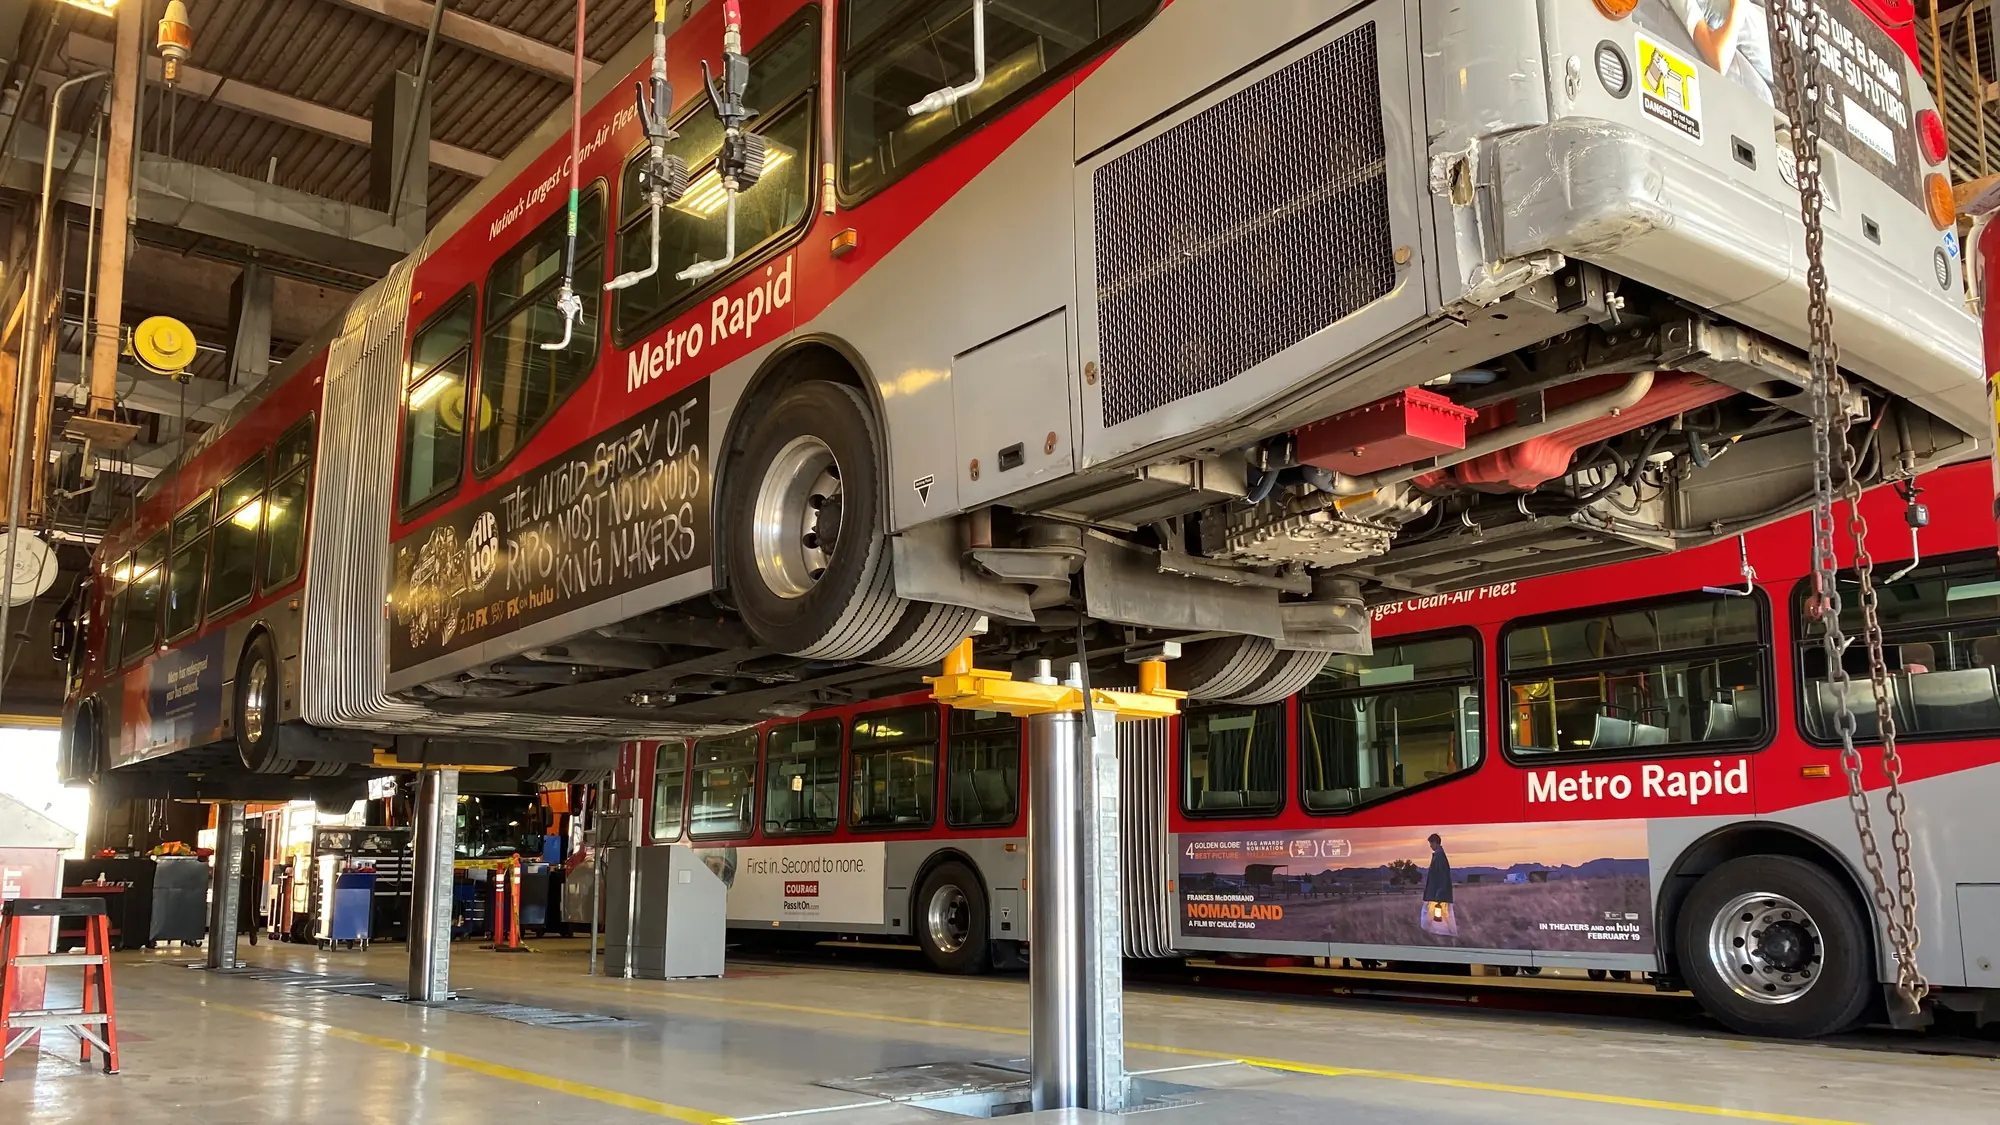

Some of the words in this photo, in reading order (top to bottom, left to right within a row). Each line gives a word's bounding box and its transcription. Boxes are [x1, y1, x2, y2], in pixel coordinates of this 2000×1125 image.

[1855, 35, 1869, 68] EL
[1868, 48, 1902, 96] PLOMO
[1843, 56, 1862, 92] SU
[1863, 71, 1907, 130] FUTURO
[1644, 97, 1672, 121] DANGER
[488, 196, 525, 241] Nation's
[525, 164, 562, 209] Largest
[562, 124, 610, 178] Can-Air
[627, 323, 704, 394] Metro
[710, 254, 793, 346] Rapid
[500, 485, 532, 532] THE
[532, 460, 588, 522] UNTOLD
[593, 418, 659, 488] STORY
[666, 397, 698, 457] OF
[557, 491, 608, 554] MOST
[608, 443, 700, 526] NOTORIOUS
[470, 511, 497, 555] HIP
[470, 536, 498, 582] HOP
[555, 540, 602, 600] KING
[608, 501, 695, 585] MAKERS
[507, 596, 520, 620] FX
[529, 584, 553, 610] hulu
[1370, 601, 1403, 621] rgest
[1479, 582, 1517, 600] Fleet
[475, 606, 488, 629] FX
[1527, 770, 1632, 803] Metro
[1641, 759, 1748, 805] Rapid
[1185, 842, 1195, 859] 4
[1194, 841, 1218, 849] GOLDEN
[1195, 851, 1212, 859] BEST
[1212, 851, 1239, 859] PICTURE
[747, 857, 767, 874] First
[769, 857, 780, 874] in.
[781, 856, 820, 874] Second
[823, 857, 834, 873] to
[836, 858, 866, 874] none.
[786, 884, 818, 894] COURAGE
[1187, 894, 1214, 902] FRANCES
[1214, 894, 1254, 902] McDORMAND
[1187, 903, 1284, 920] NOMADLAND
[1194, 920, 1208, 928] FILM
[1216, 920, 1237, 929] CHLOÉ
[1549, 923, 1590, 931] THEATERS
[1616, 922, 1640, 932] hulu
[1587, 932, 1629, 940] FEBRUARY
[1630, 933, 1640, 941] 19
